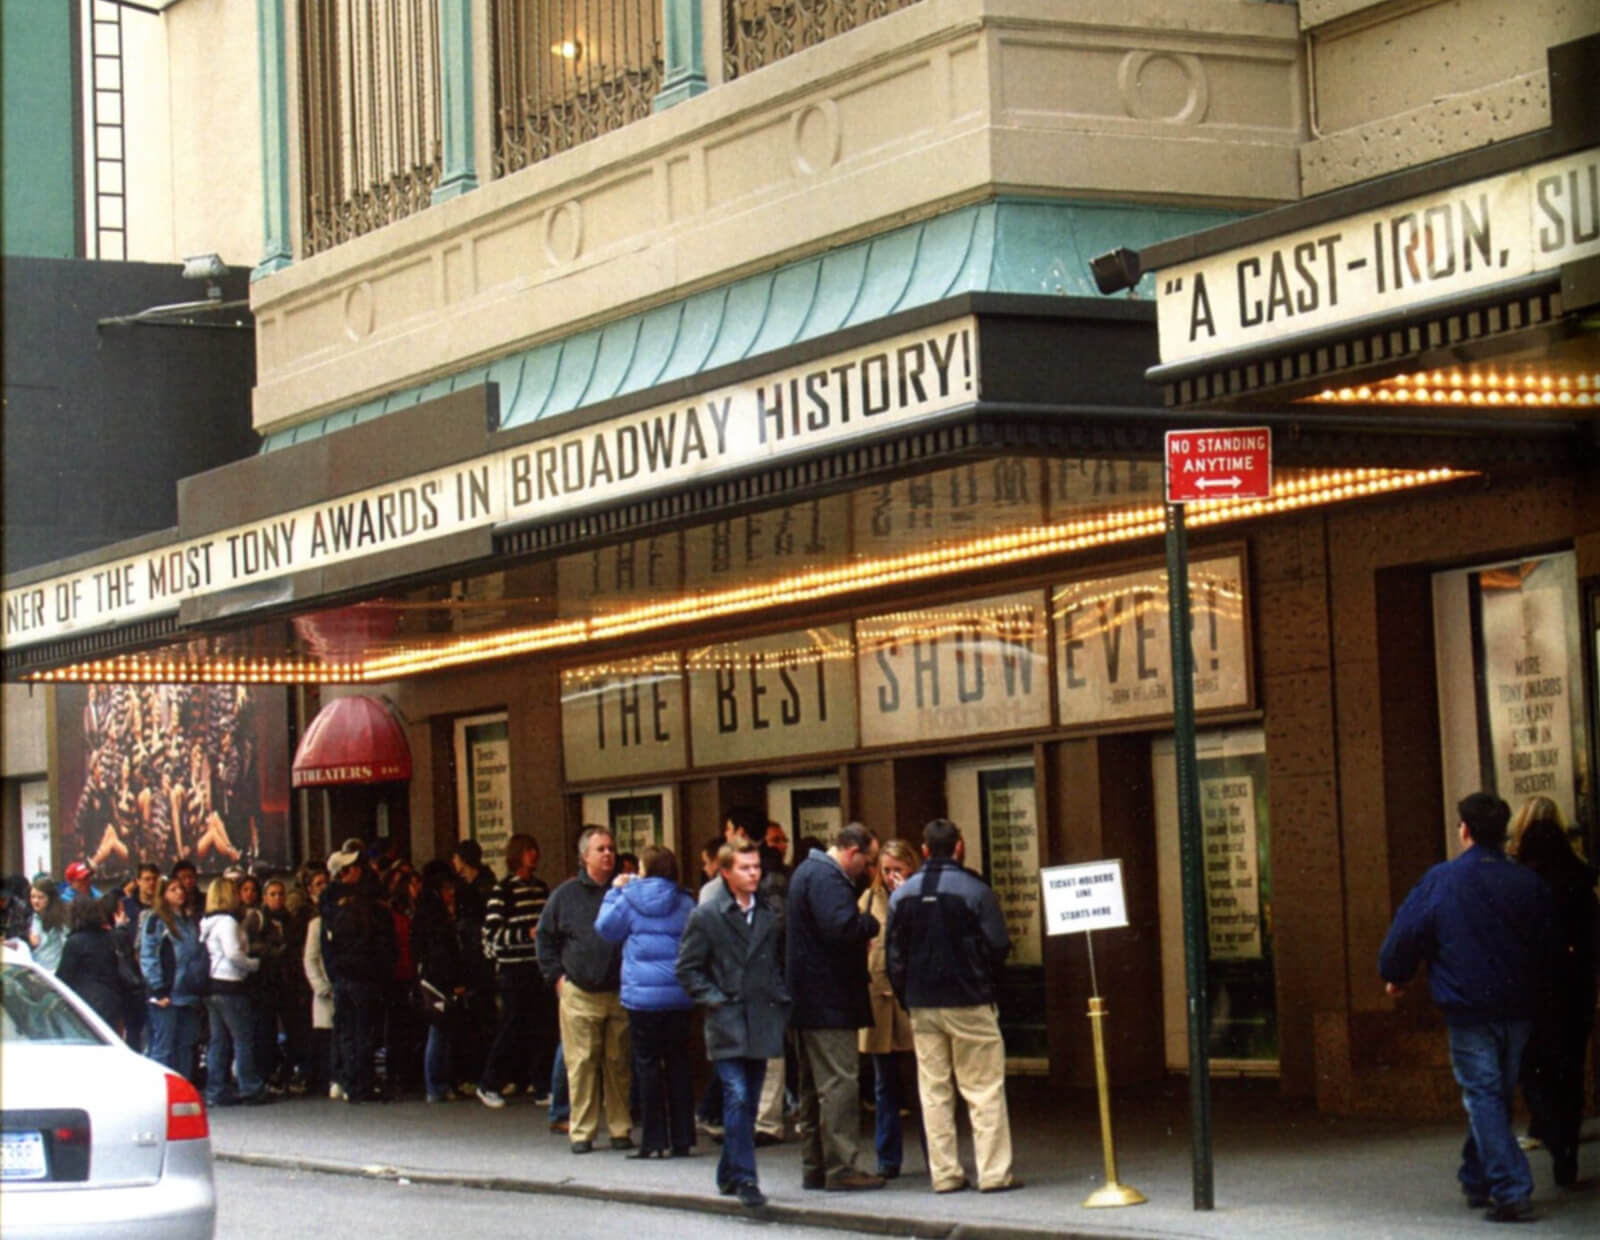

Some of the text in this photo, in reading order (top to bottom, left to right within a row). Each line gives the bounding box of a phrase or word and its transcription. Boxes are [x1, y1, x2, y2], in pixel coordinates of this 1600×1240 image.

[1236, 193, 1510, 328] CAST-IRON,
[56, 578, 82, 622] OF
[93, 563, 136, 613] THE
[147, 541, 214, 600] MOST
[227, 518, 297, 574] TONY
[456, 465, 491, 521] IN
[511, 397, 732, 507] BROADWAY
[756, 329, 973, 445] HISTORY!
[1170, 436, 1266, 454] NO STANDING
[1183, 456, 1255, 473] ANYTIME
[590, 669, 671, 751] THE
[716, 641, 834, 734] BEST
[875, 609, 1035, 714] SHOW
